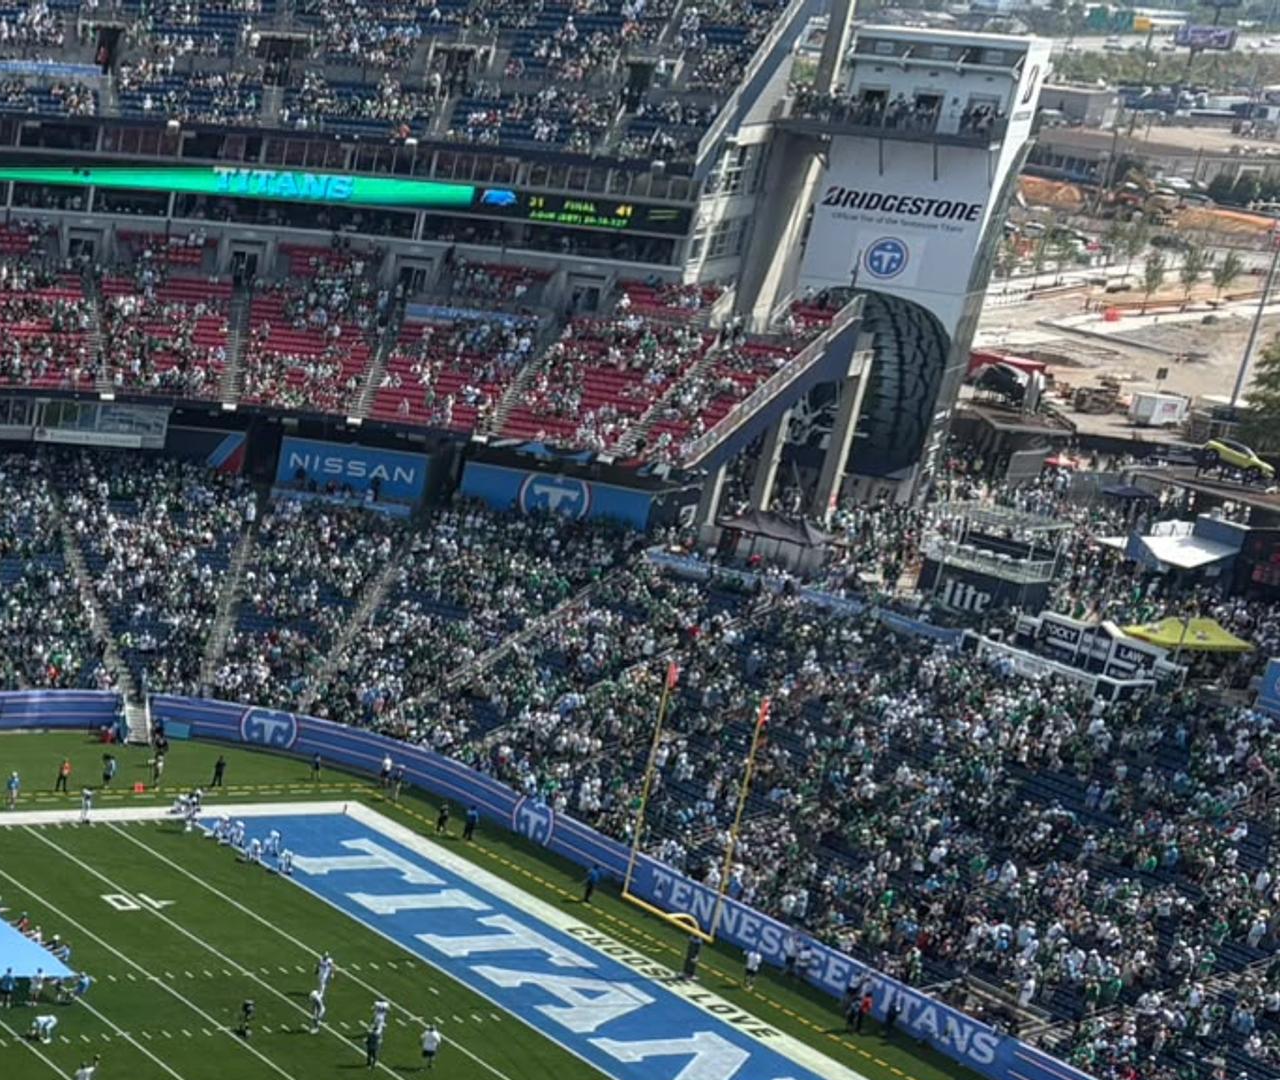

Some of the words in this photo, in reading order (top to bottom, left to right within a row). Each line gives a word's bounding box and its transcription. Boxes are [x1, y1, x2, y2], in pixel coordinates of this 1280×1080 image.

[213, 166, 354, 199] TITANS
[821, 186, 982, 223] BRIDGESTONE
[289, 453, 415, 483] NISSAN
[650, 866, 851, 993] TENNESEE
[690, 989, 784, 1042] LOVE
